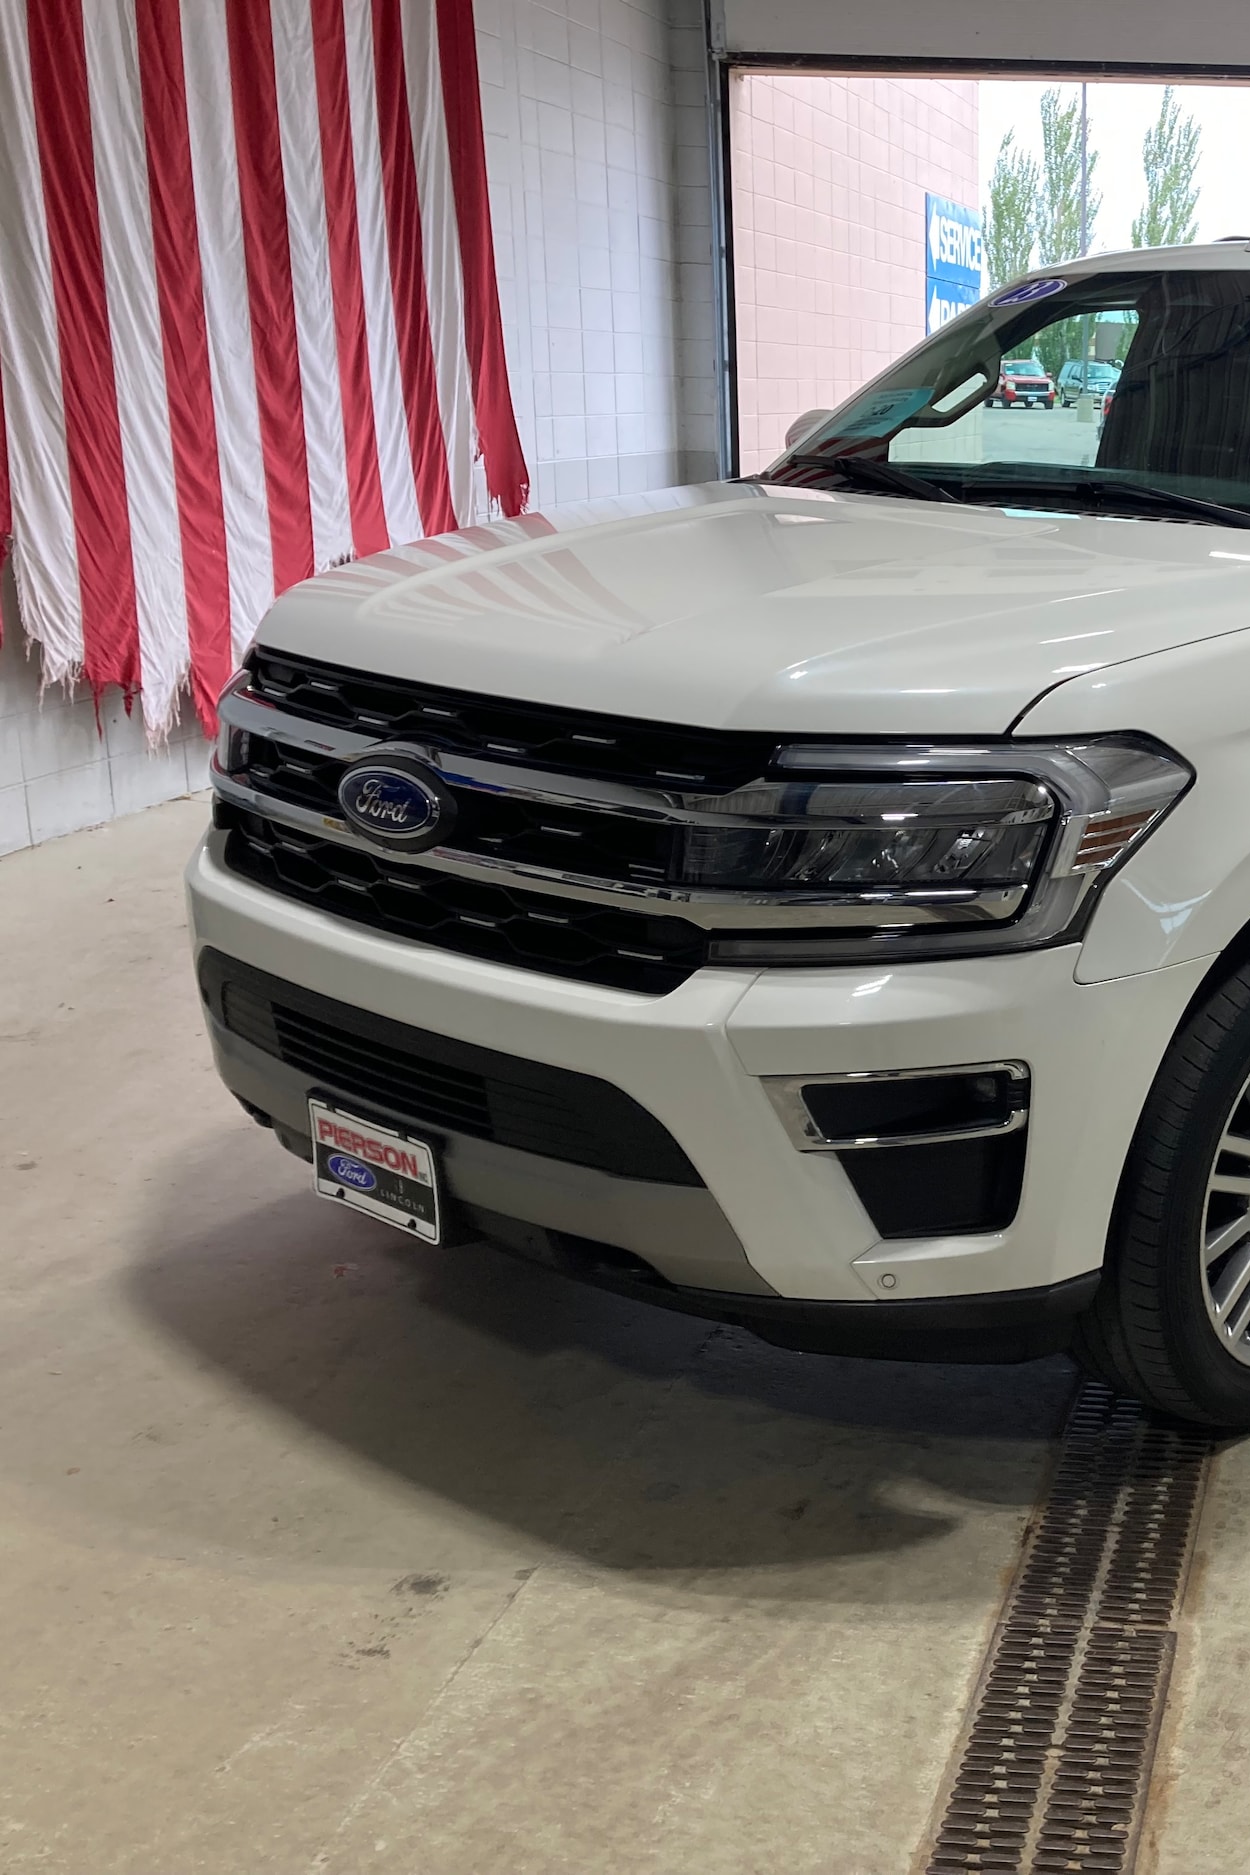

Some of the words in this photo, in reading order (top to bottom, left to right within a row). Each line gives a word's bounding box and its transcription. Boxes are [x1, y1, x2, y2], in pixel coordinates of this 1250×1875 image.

[940, 219, 982, 271] SERVICE
[356, 780, 411, 823] Ford
[317, 1118, 418, 1177] PIERSON
[337, 1158, 367, 1185] Ford
